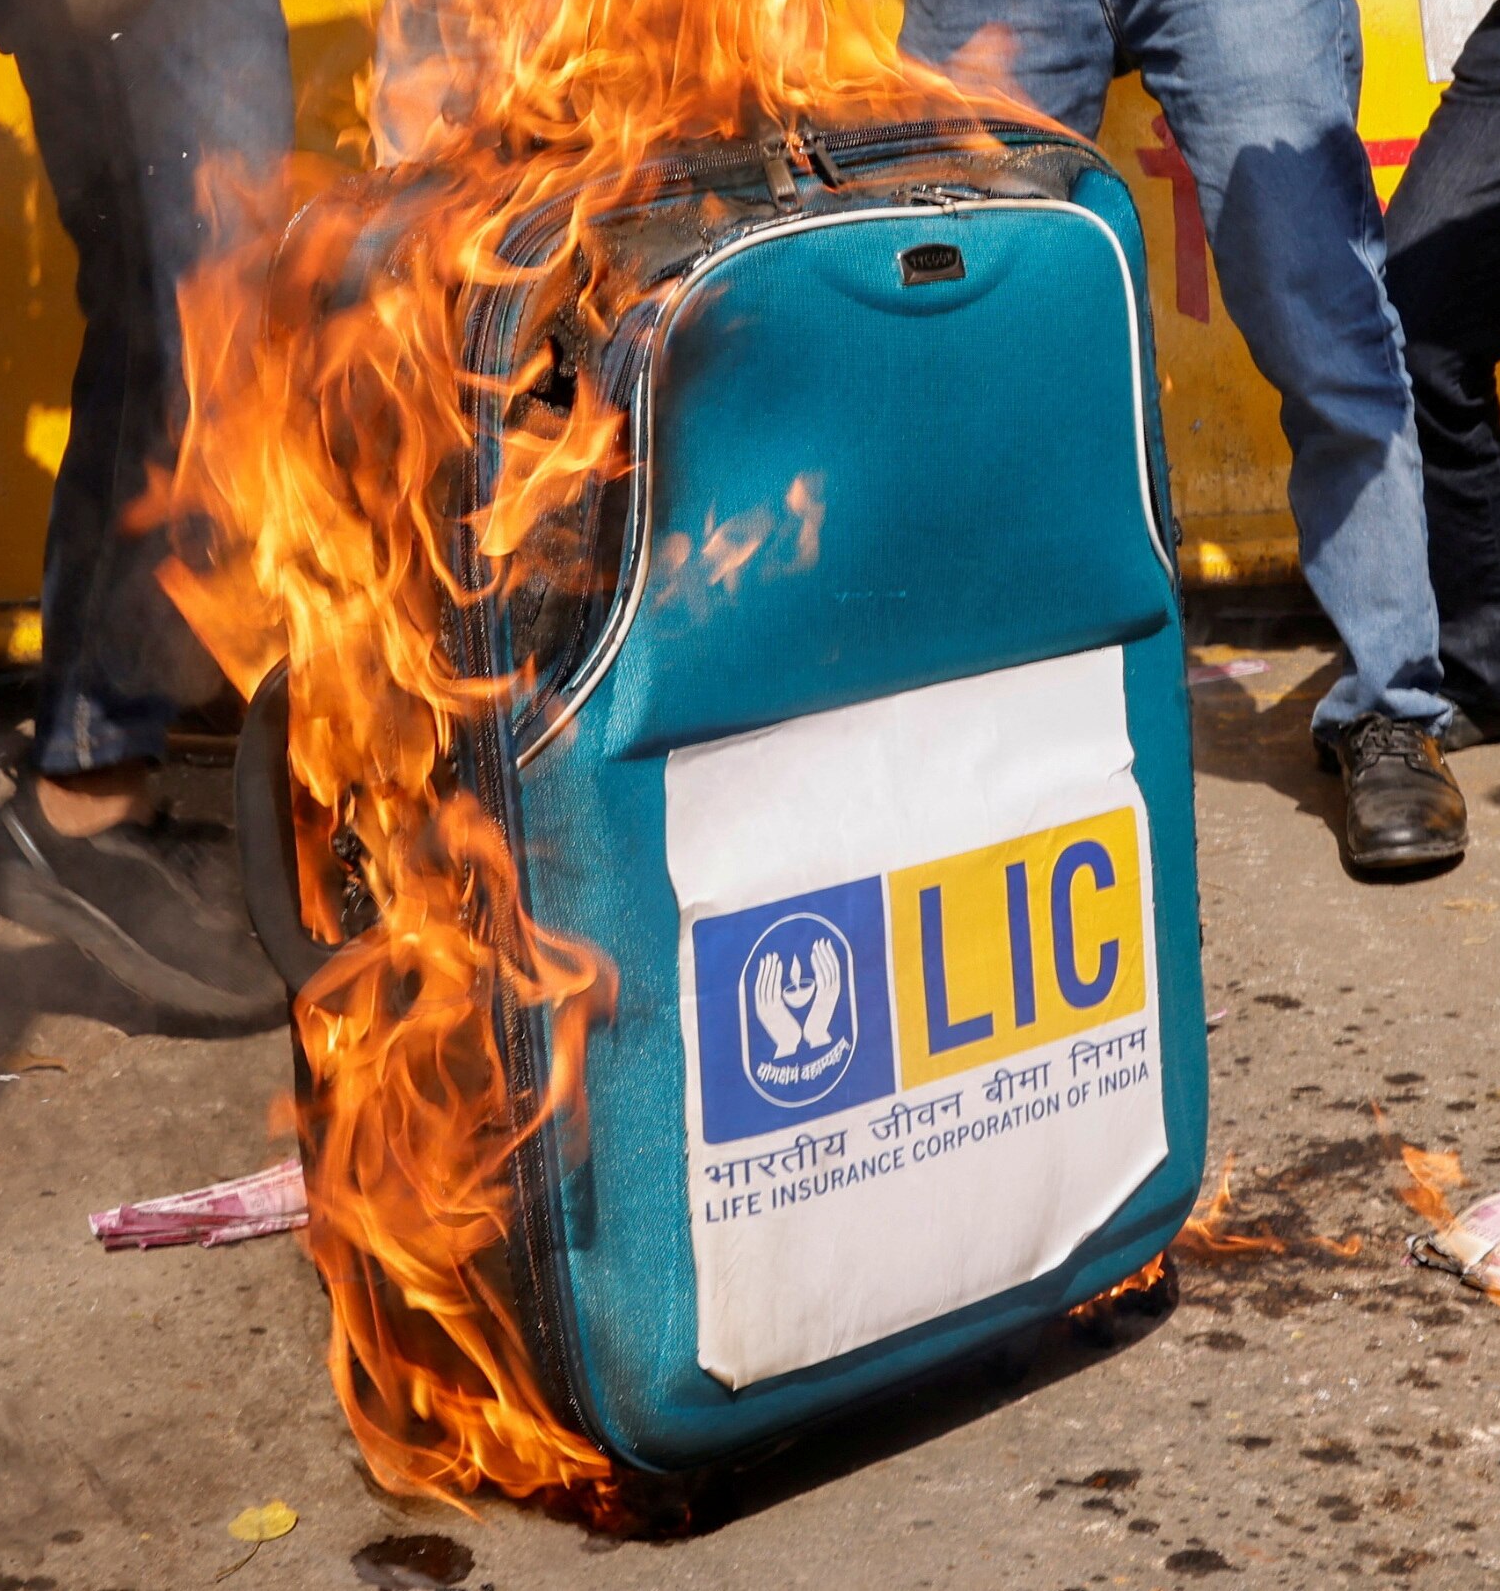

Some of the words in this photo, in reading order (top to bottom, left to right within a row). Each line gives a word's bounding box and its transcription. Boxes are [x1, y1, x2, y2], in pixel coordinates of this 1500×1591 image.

[919, 840, 1119, 1056] LIC
[705, 1128, 848, 1189] भारतीय
[870, 1090, 963, 1141] जीवन
[982, 1060, 1051, 1107] बीमा
[1069, 1026, 1148, 1078] निगम
[705, 1192, 763, 1224] LIFE
[771, 1149, 905, 1210] INSURANCE
[912, 1099, 1060, 1163] CORPORATION
[1067, 1083, 1090, 1108] OF
[1098, 1062, 1150, 1099] INDIA
